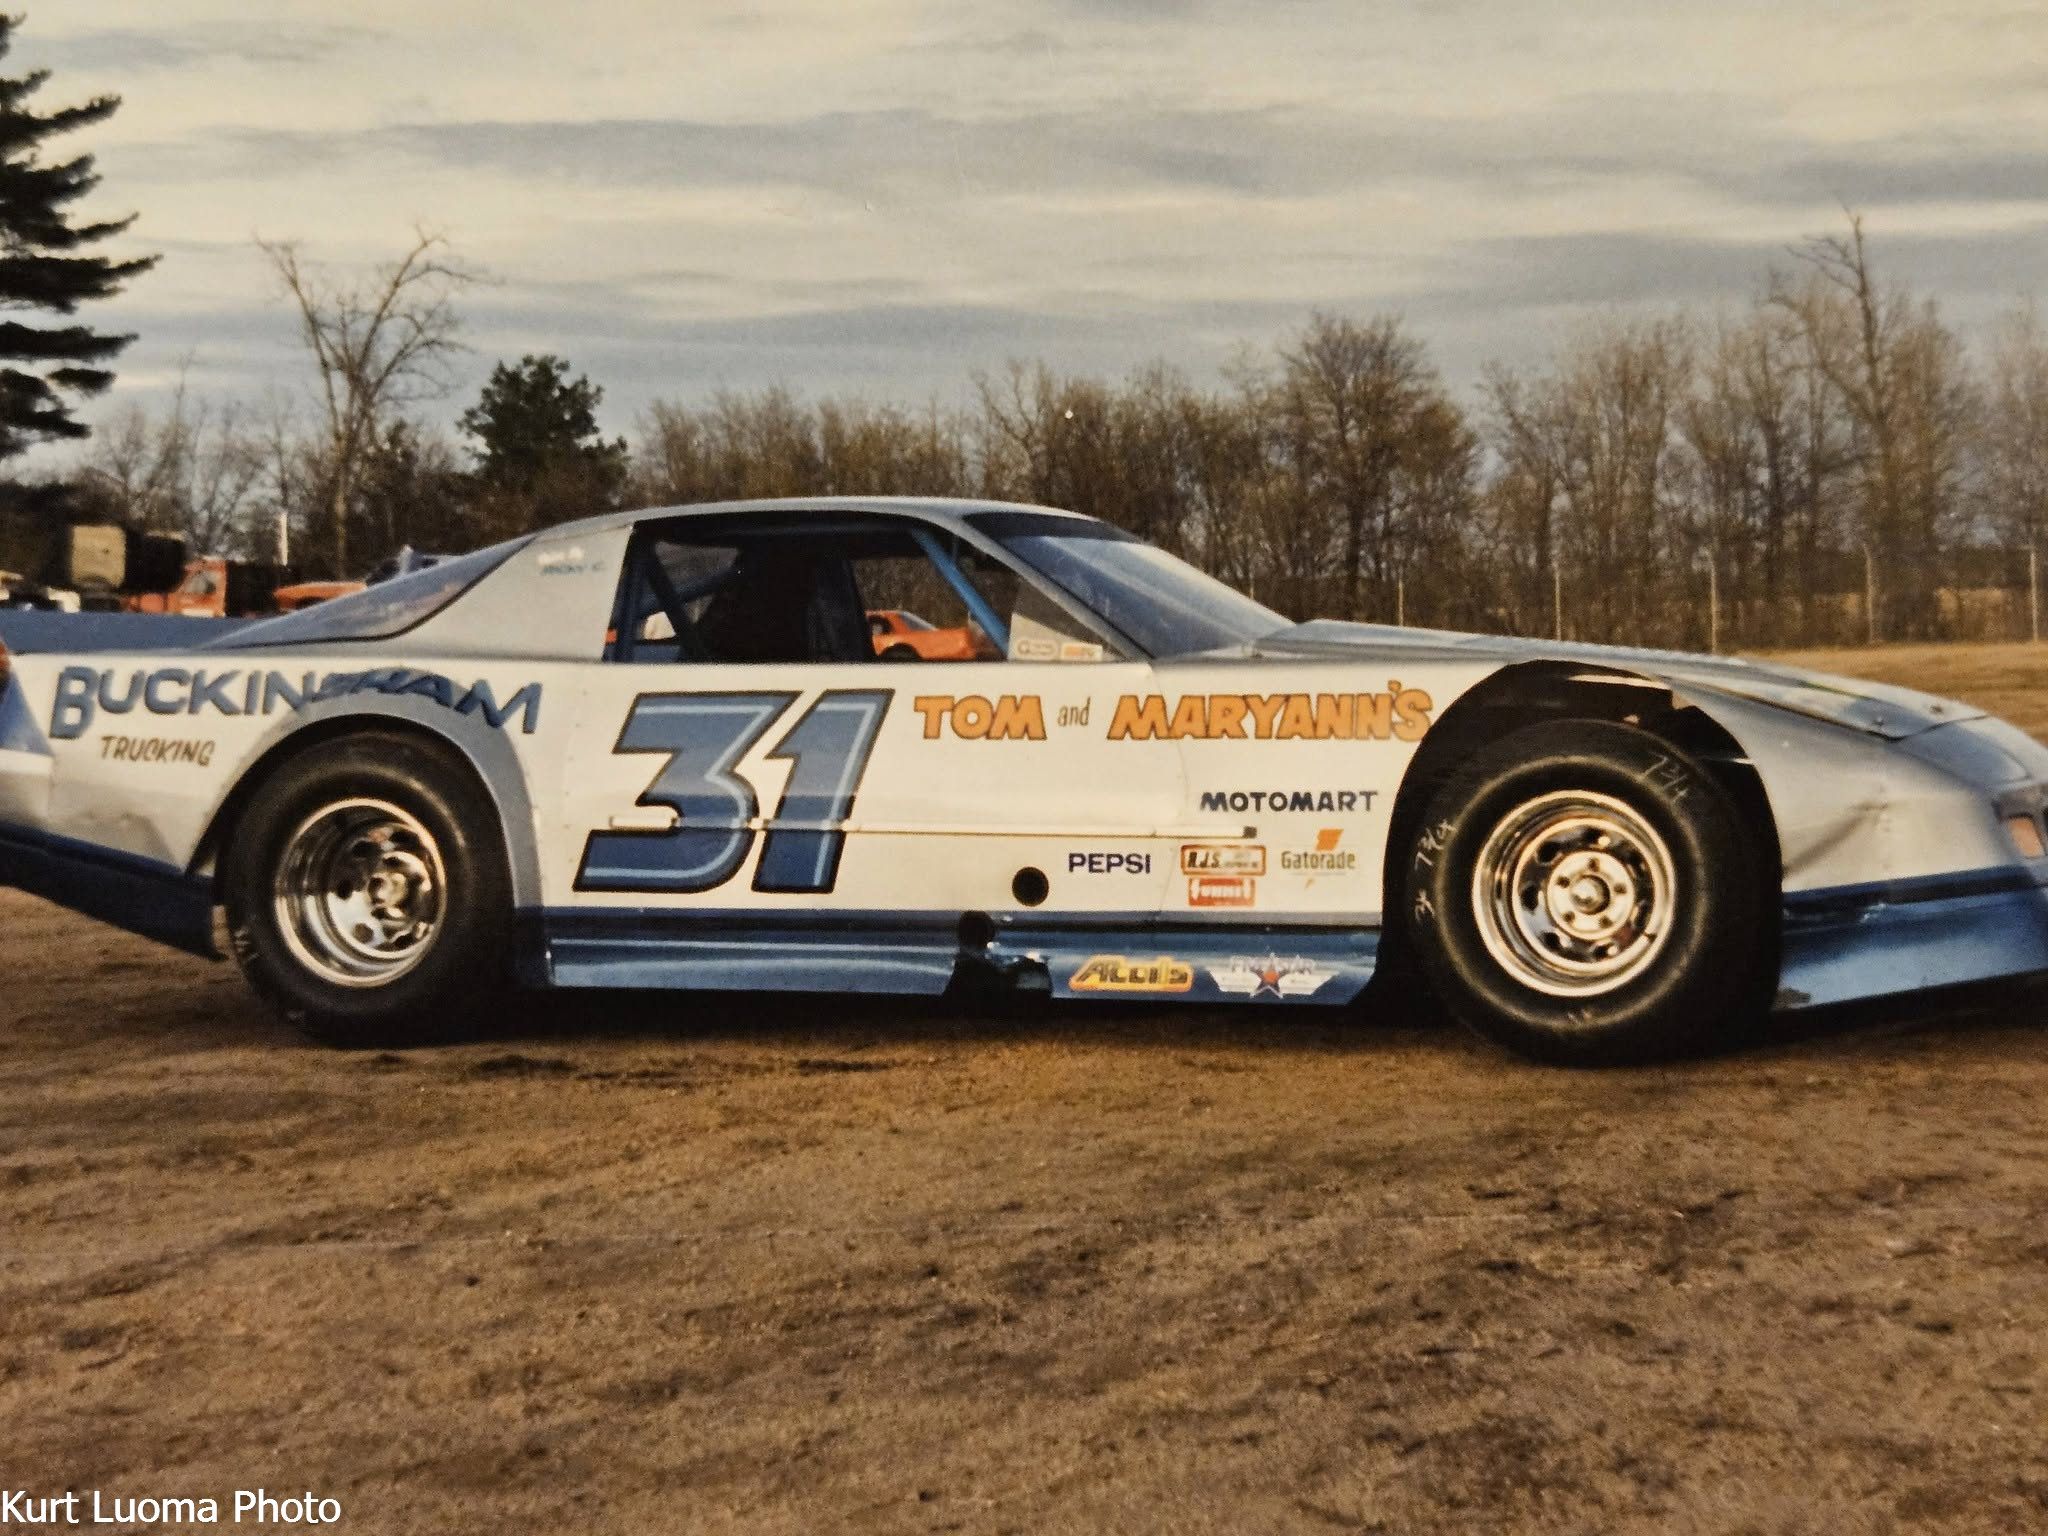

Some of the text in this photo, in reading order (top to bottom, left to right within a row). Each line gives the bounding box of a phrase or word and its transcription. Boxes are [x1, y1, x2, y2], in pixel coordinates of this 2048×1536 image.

[913, 679, 1434, 742] TOM and MARYANN'S
[100, 735, 216, 767] TRUCKING
[571, 688, 896, 894] 31
[1200, 790, 1379, 813] MOTOMART
[1068, 853, 1152, 875] PEPSI
[1281, 851, 1357, 870] Gatorade
